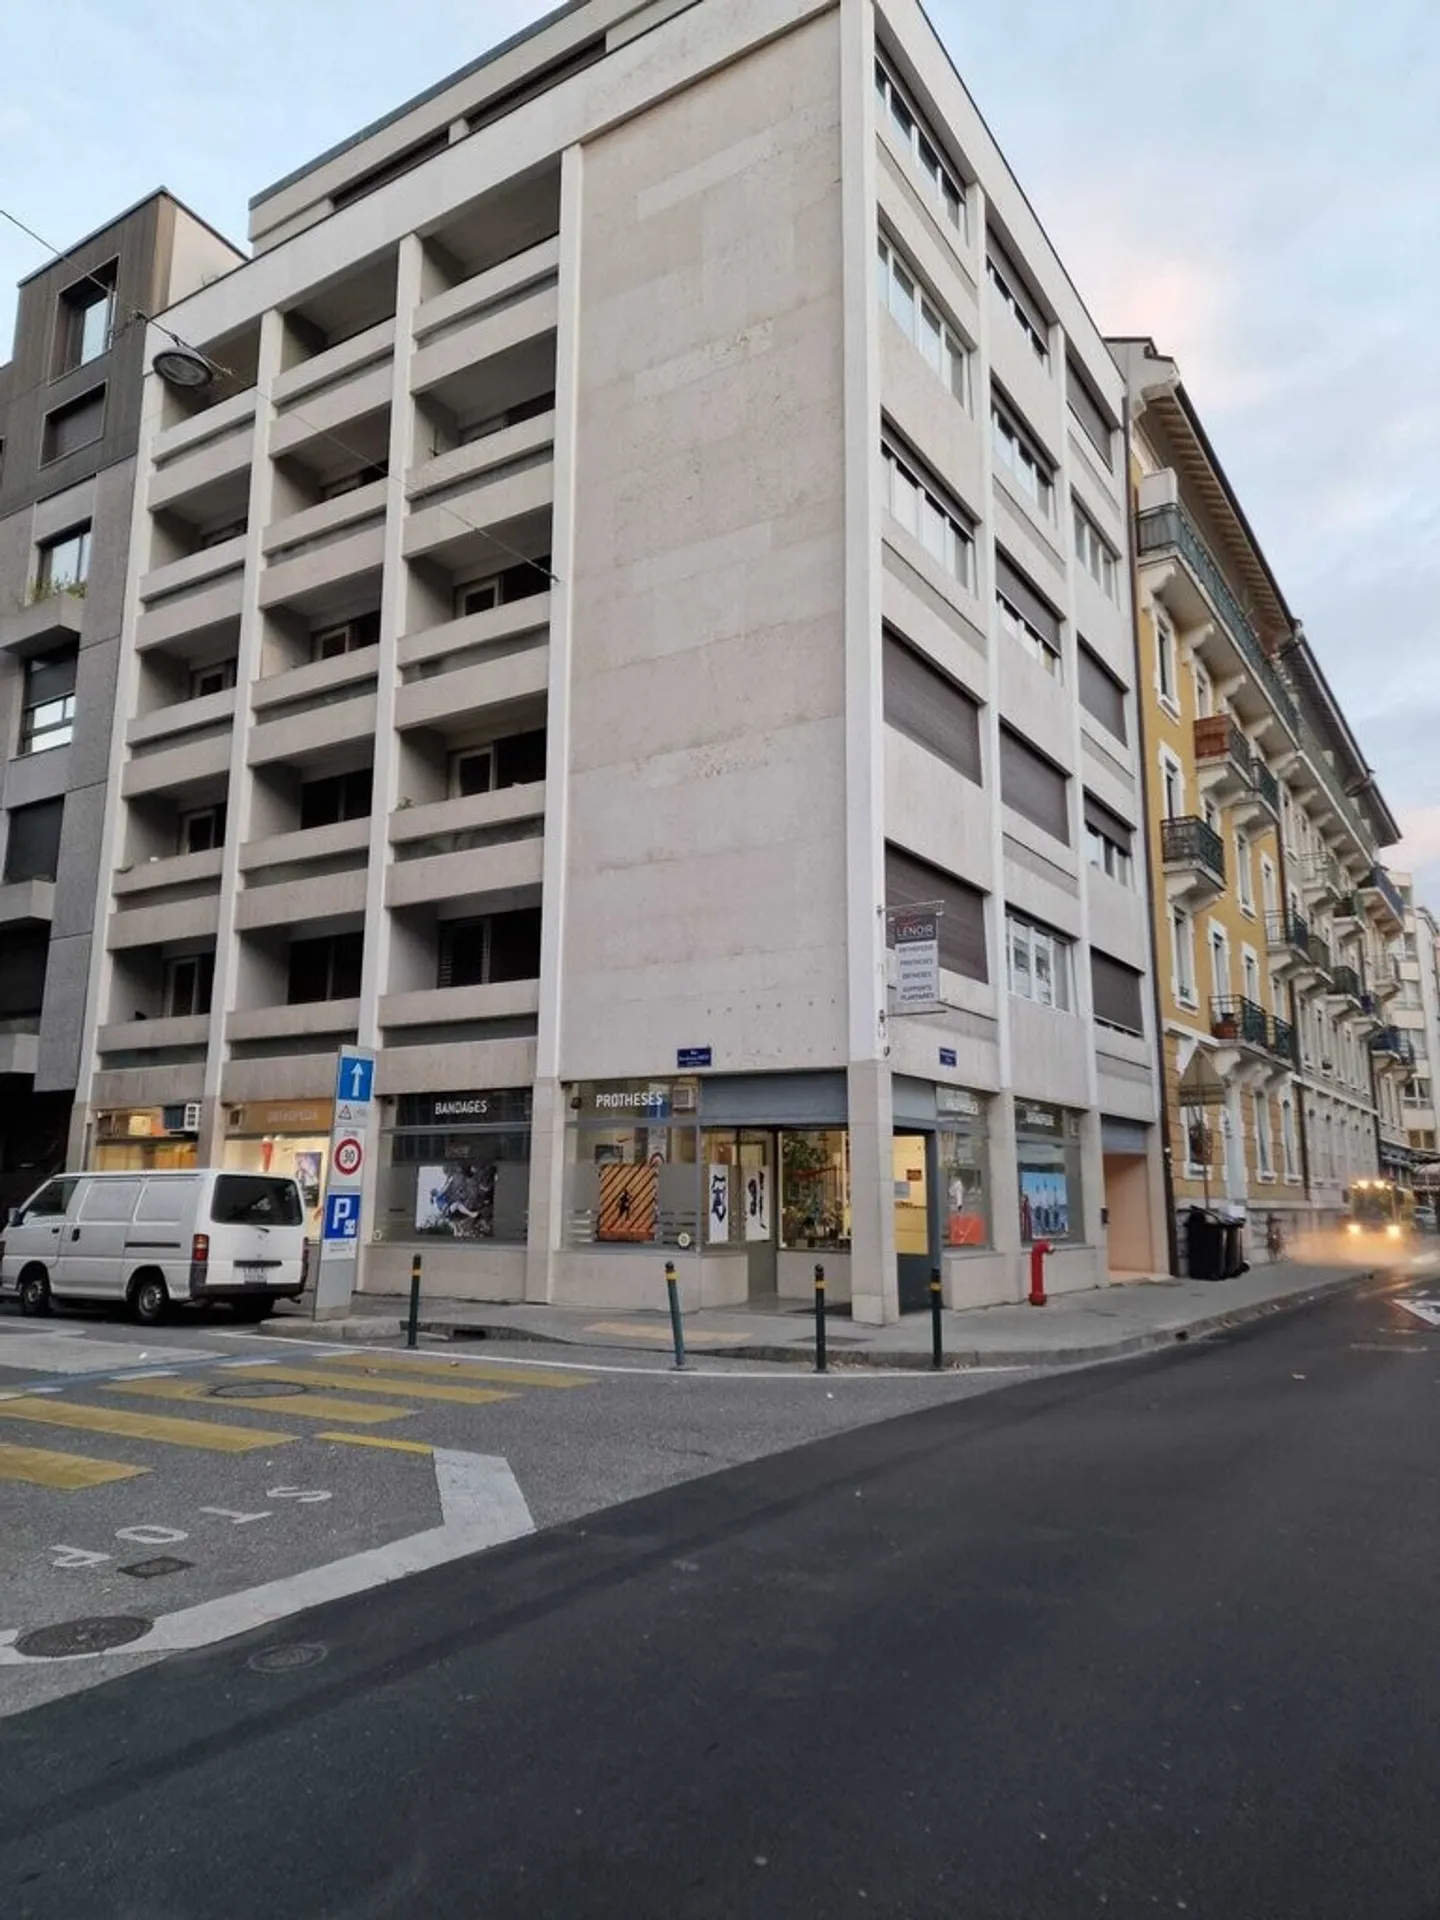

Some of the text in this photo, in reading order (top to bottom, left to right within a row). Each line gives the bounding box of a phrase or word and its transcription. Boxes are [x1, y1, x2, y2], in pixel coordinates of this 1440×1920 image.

[434, 1100, 488, 1115] BANDAGES
[595, 1091, 663, 1108] PROTHESES
[343, 1149, 356, 1164] 30
[332, 1198, 352, 1229] P
[48, 1486, 333, 1569] STOP
